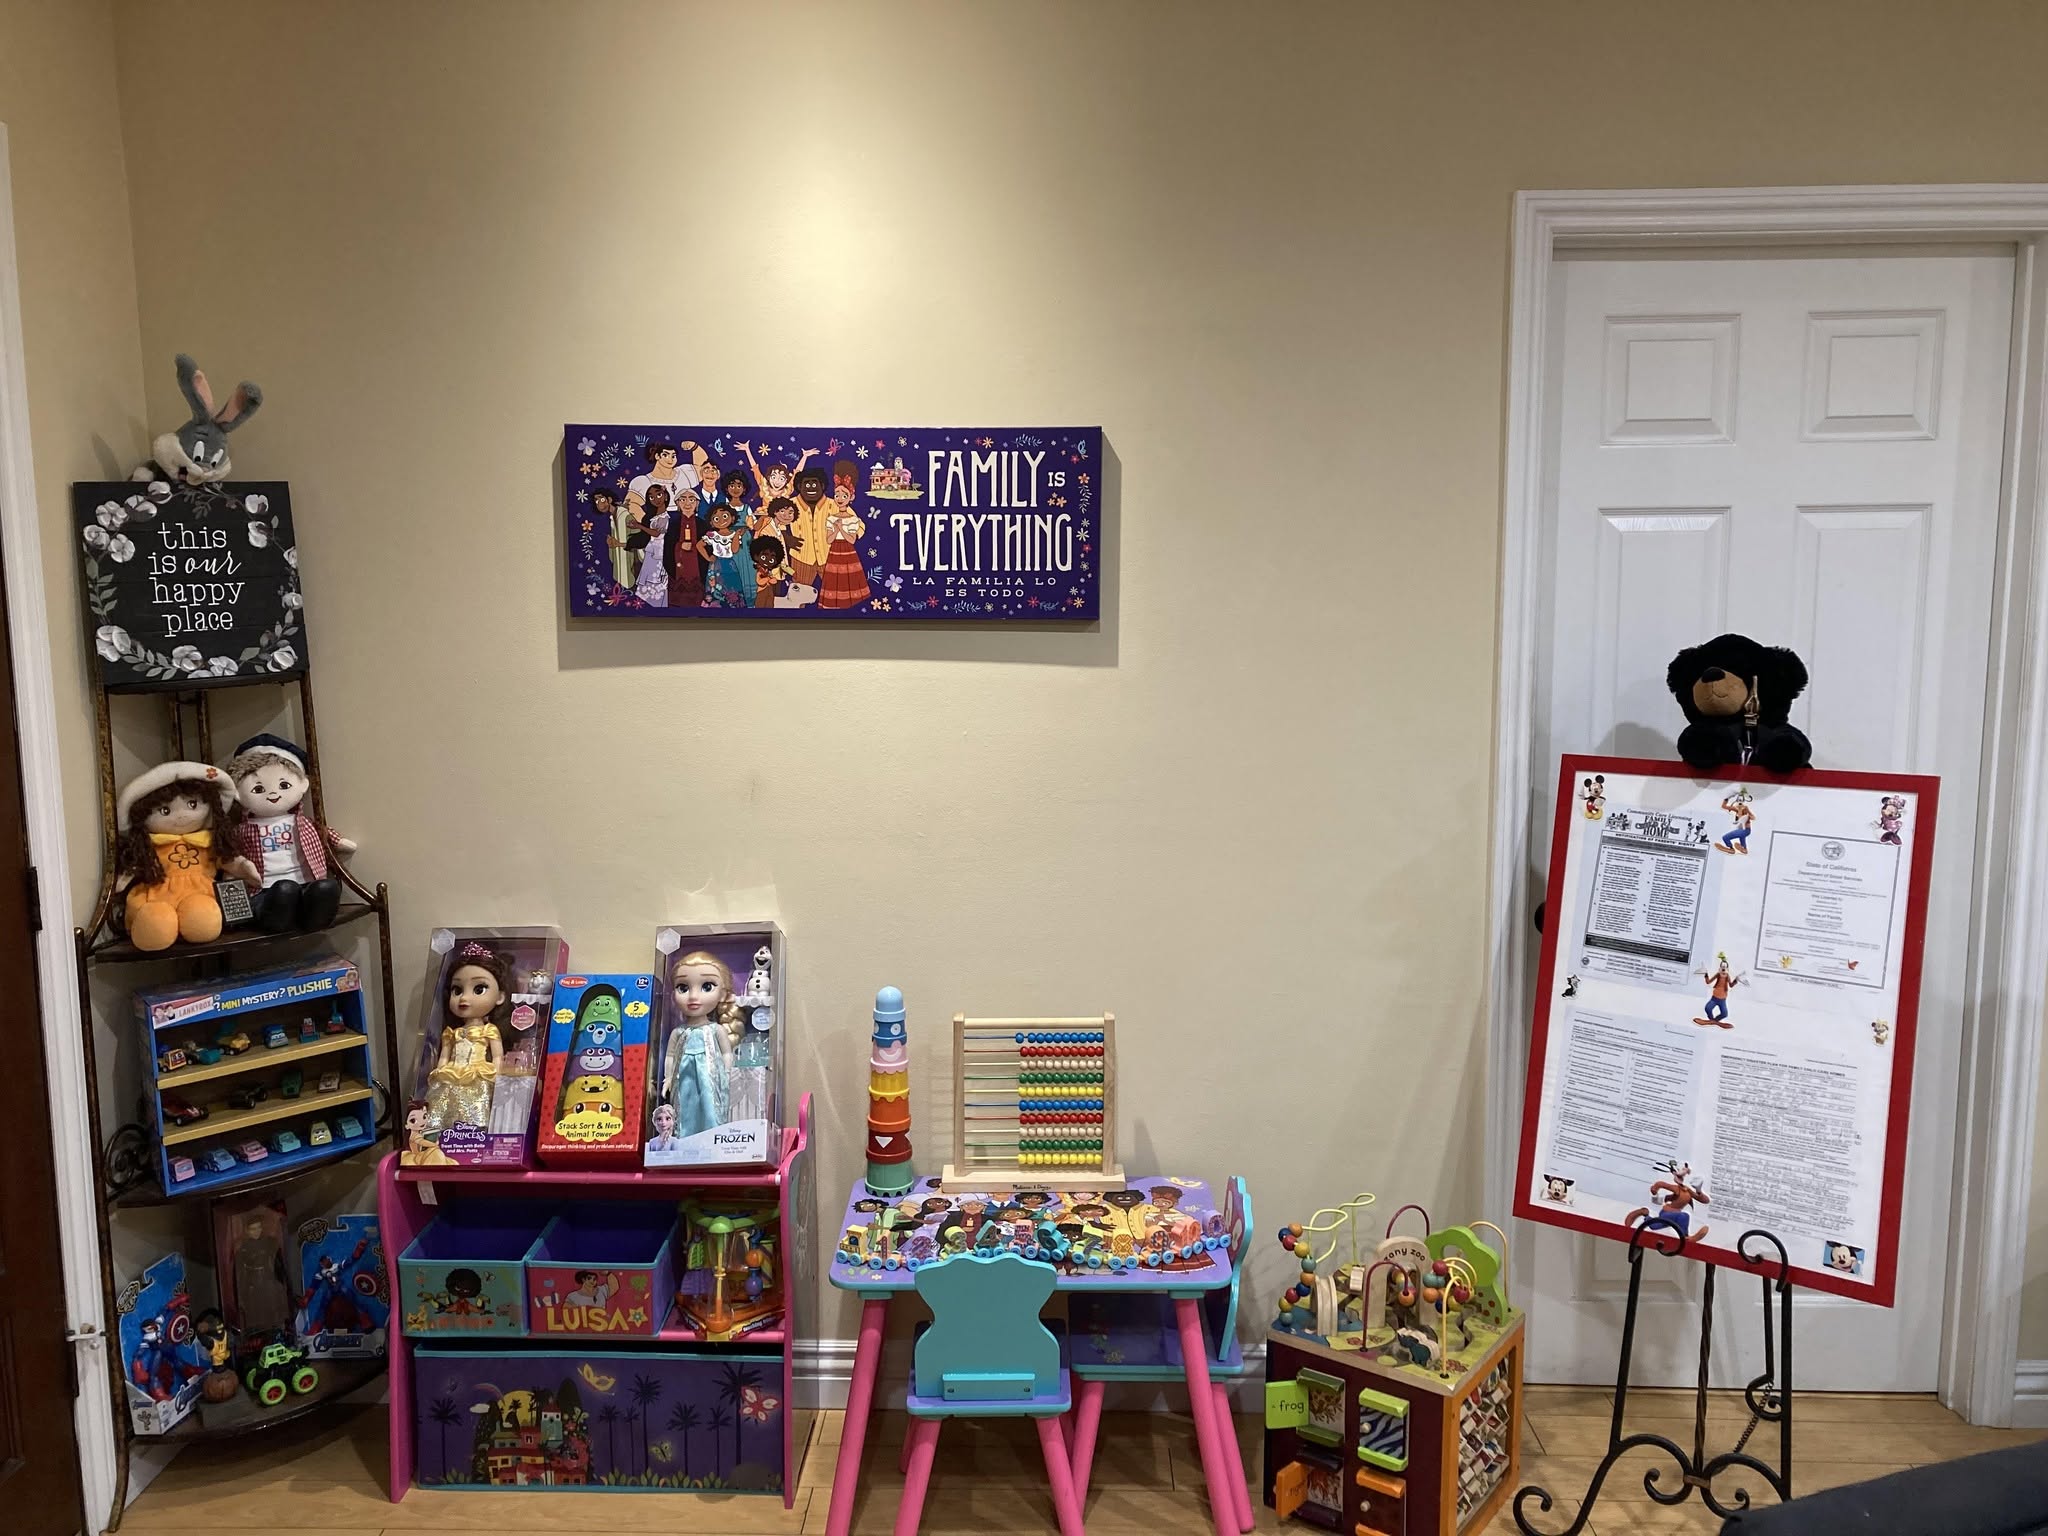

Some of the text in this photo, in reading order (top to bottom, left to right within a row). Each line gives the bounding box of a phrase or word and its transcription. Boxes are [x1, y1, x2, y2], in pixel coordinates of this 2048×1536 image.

[928, 450, 1066, 508] FAMILY IS
[158, 522, 227, 550] this
[889, 513, 1073, 572] EVERYTHING
[147, 551, 242, 576] is our
[148, 577, 246, 606] happy
[913, 577, 1057, 586] LA FAMILIA LO
[945, 589, 1025, 597] ES TODO
[161, 605, 234, 638] place
[242, 988, 286, 1006] MYSTERY?
[286, 978, 333, 998] PLUSHIE
[632, 1002, 640, 1012] 5
[558, 1122, 578, 1130] Stack
[596, 1121, 603, 1129] &
[714, 1133, 755, 1144] FROZEN
[1410, 1248, 1426, 1262] zoo
[546, 1306, 629, 1332] LUISA
[1279, 1399, 1305, 1414] frog
